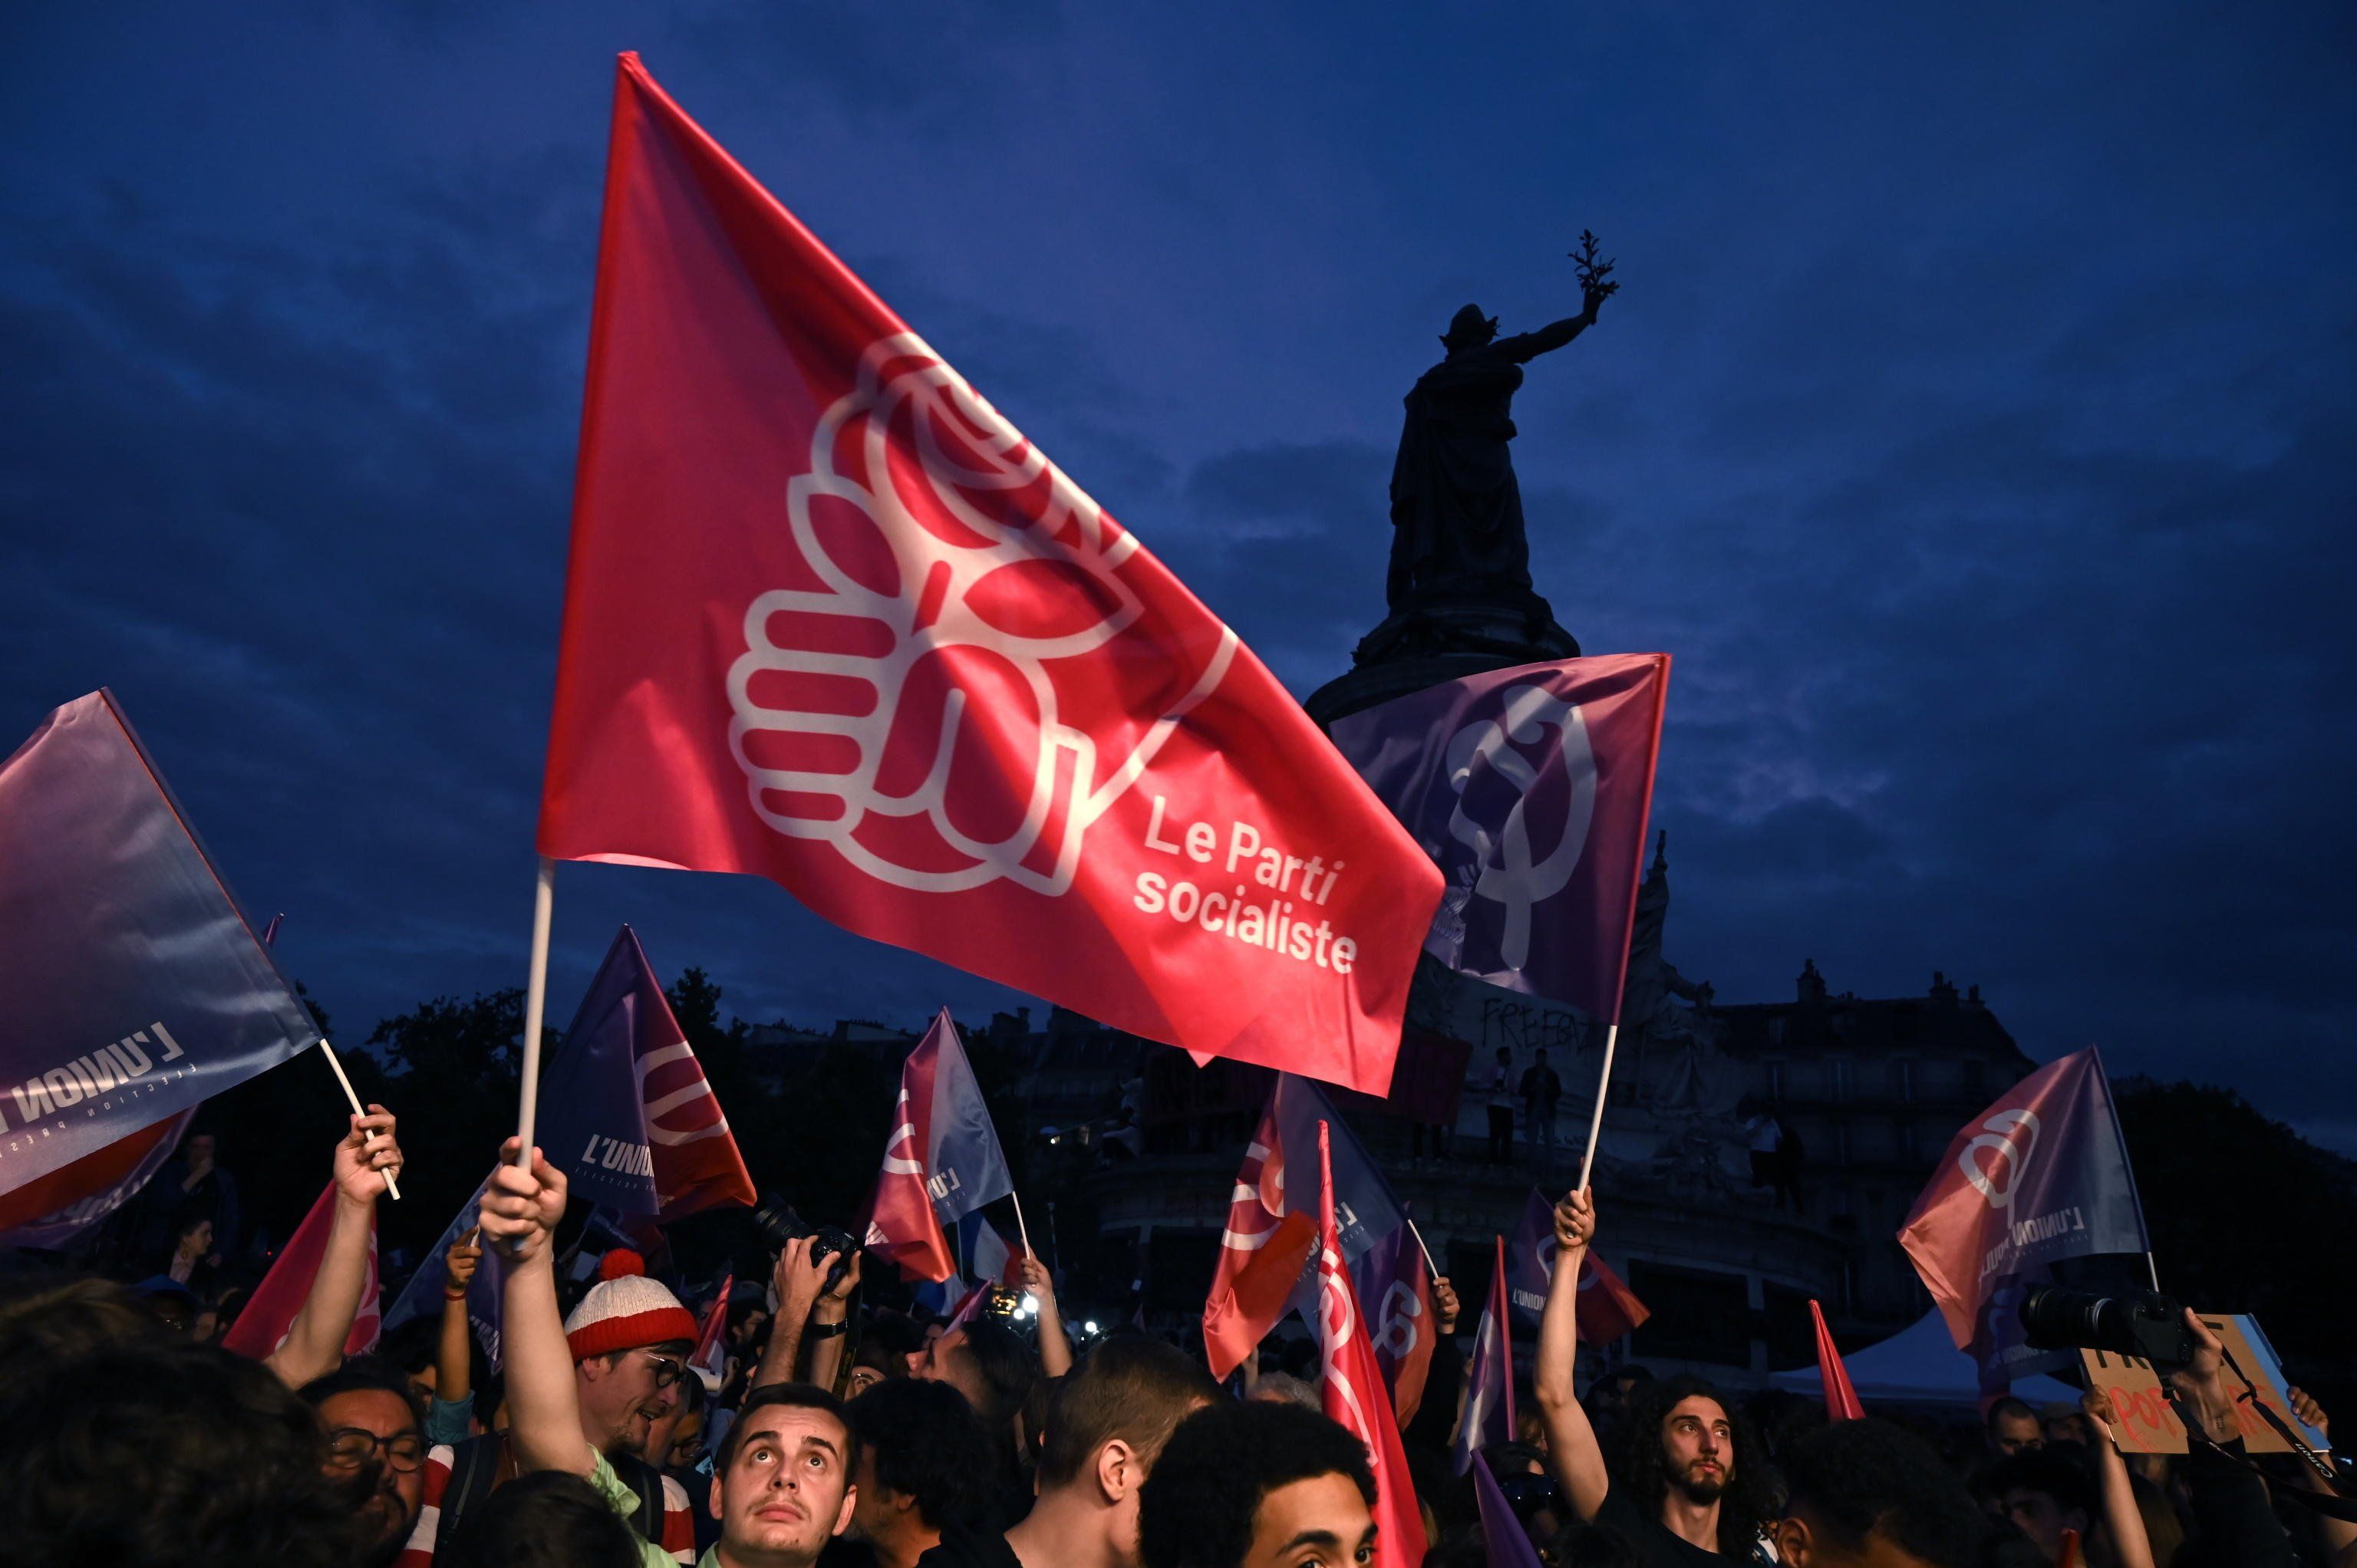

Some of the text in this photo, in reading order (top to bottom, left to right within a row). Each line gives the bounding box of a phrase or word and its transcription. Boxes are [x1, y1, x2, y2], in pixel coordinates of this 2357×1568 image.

[1144, 795, 1346, 906] Le Parti
[1132, 871, 1358, 975] socialiste
[581, 1133, 655, 1178] L'UNIO
[2295, 1442, 2333, 1479] Canon
